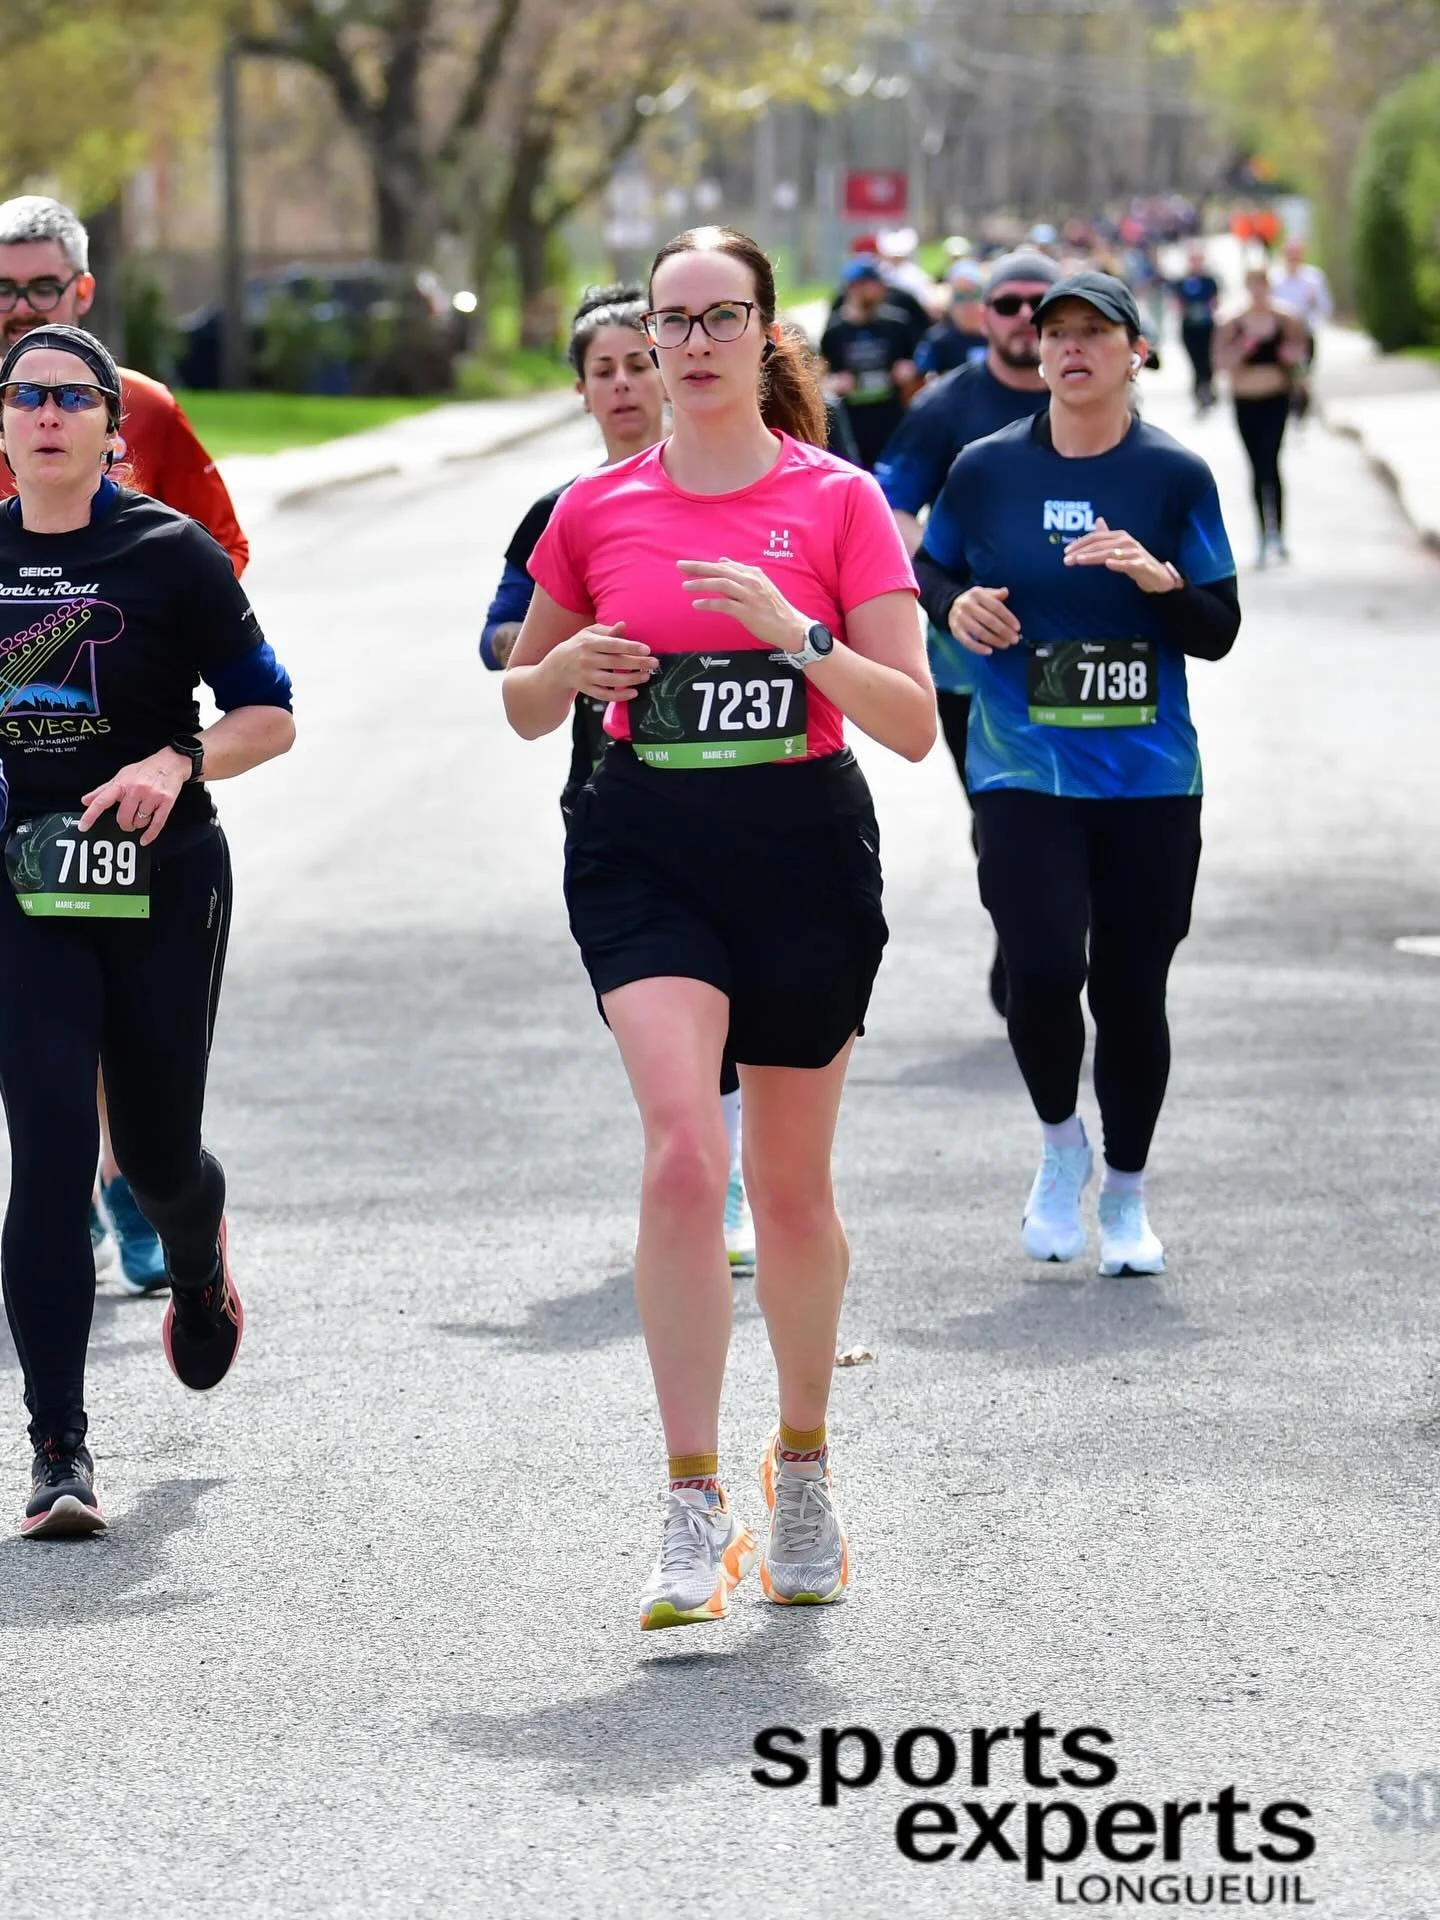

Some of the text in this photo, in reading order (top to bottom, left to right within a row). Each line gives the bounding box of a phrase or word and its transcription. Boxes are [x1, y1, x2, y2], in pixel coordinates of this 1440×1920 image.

[1043, 509, 1097, 531] NDL
[19, 567, 63, 577] GEICO
[54, 581, 100, 595] Roll
[1077, 660, 1148, 701] 7138
[692, 678, 794, 732] 7237
[28, 718, 111, 737] VEGAS
[655, 751, 669, 761] KM
[55, 839, 137, 886] 7139
